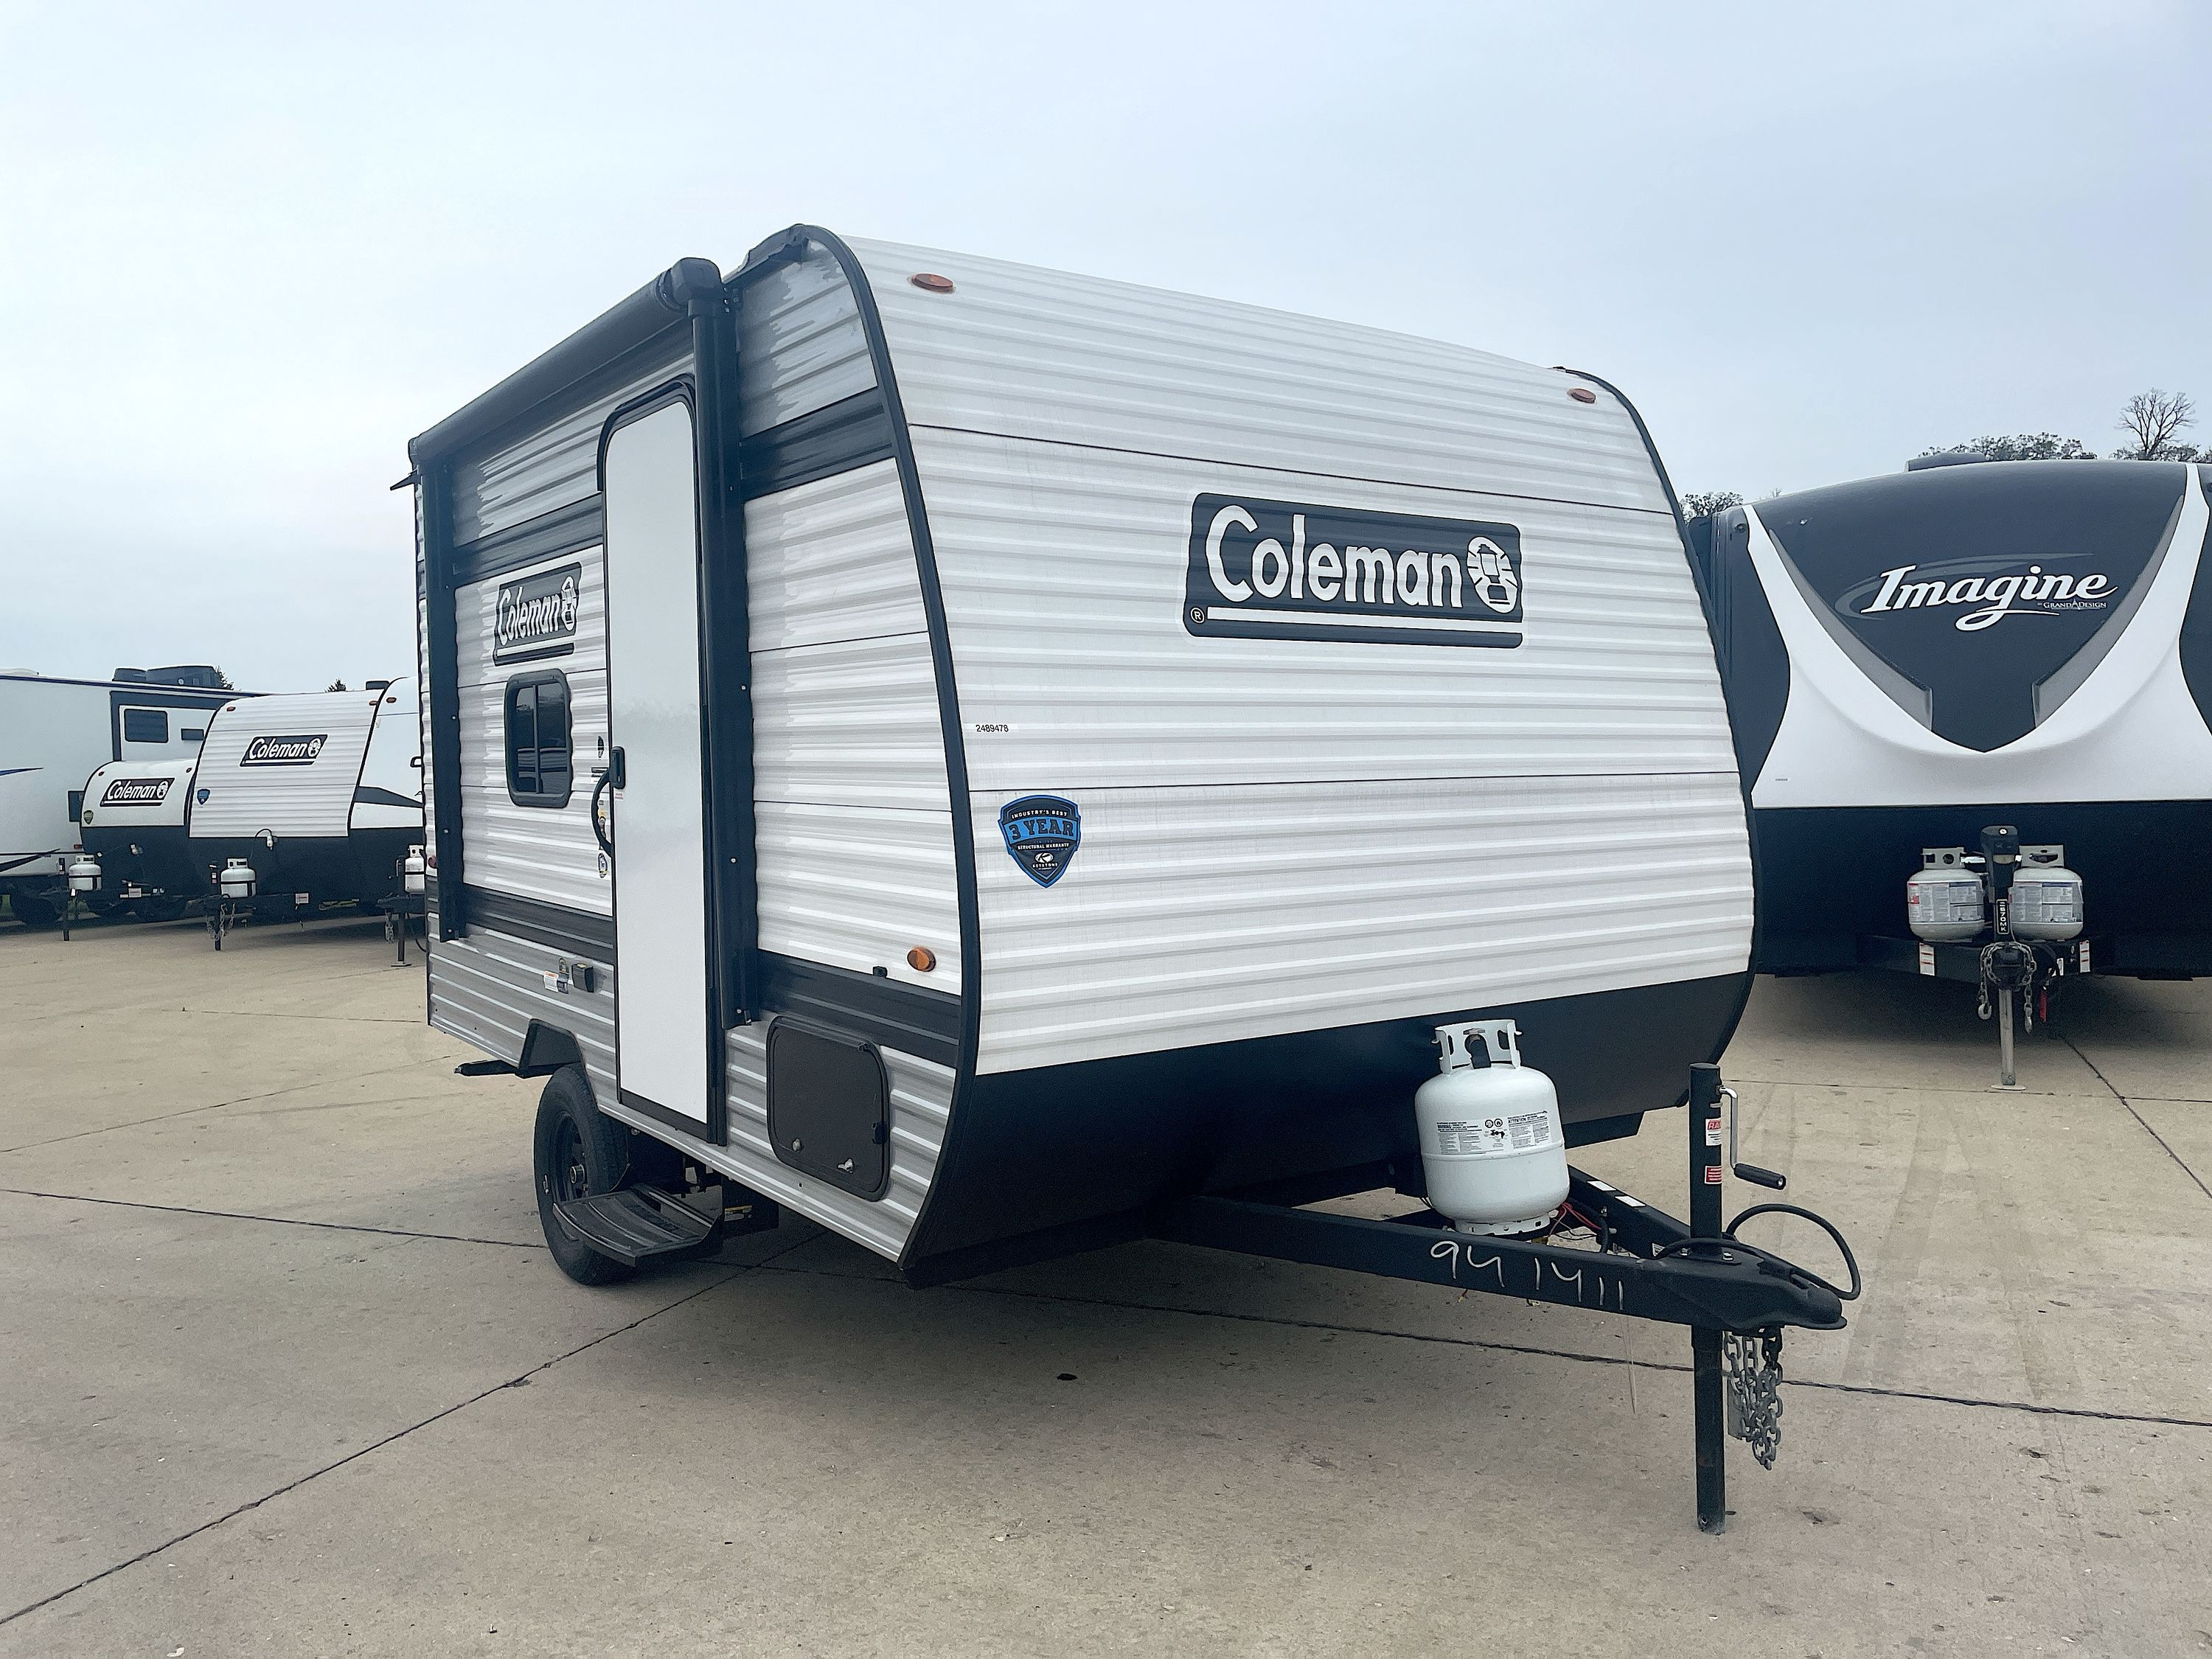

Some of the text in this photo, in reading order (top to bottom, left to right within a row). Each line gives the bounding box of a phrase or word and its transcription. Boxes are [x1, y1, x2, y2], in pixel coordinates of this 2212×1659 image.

[1206, 504, 1463, 609] Coleman
[1860, 564, 2119, 631] Imagine
[497, 585, 560, 646] Coleman
[975, 724, 1009, 732] 2489478
[248, 738, 308, 759] Coleman
[106, 780, 156, 800] Coleman
[1009, 818, 1074, 840] 3 YEAR
